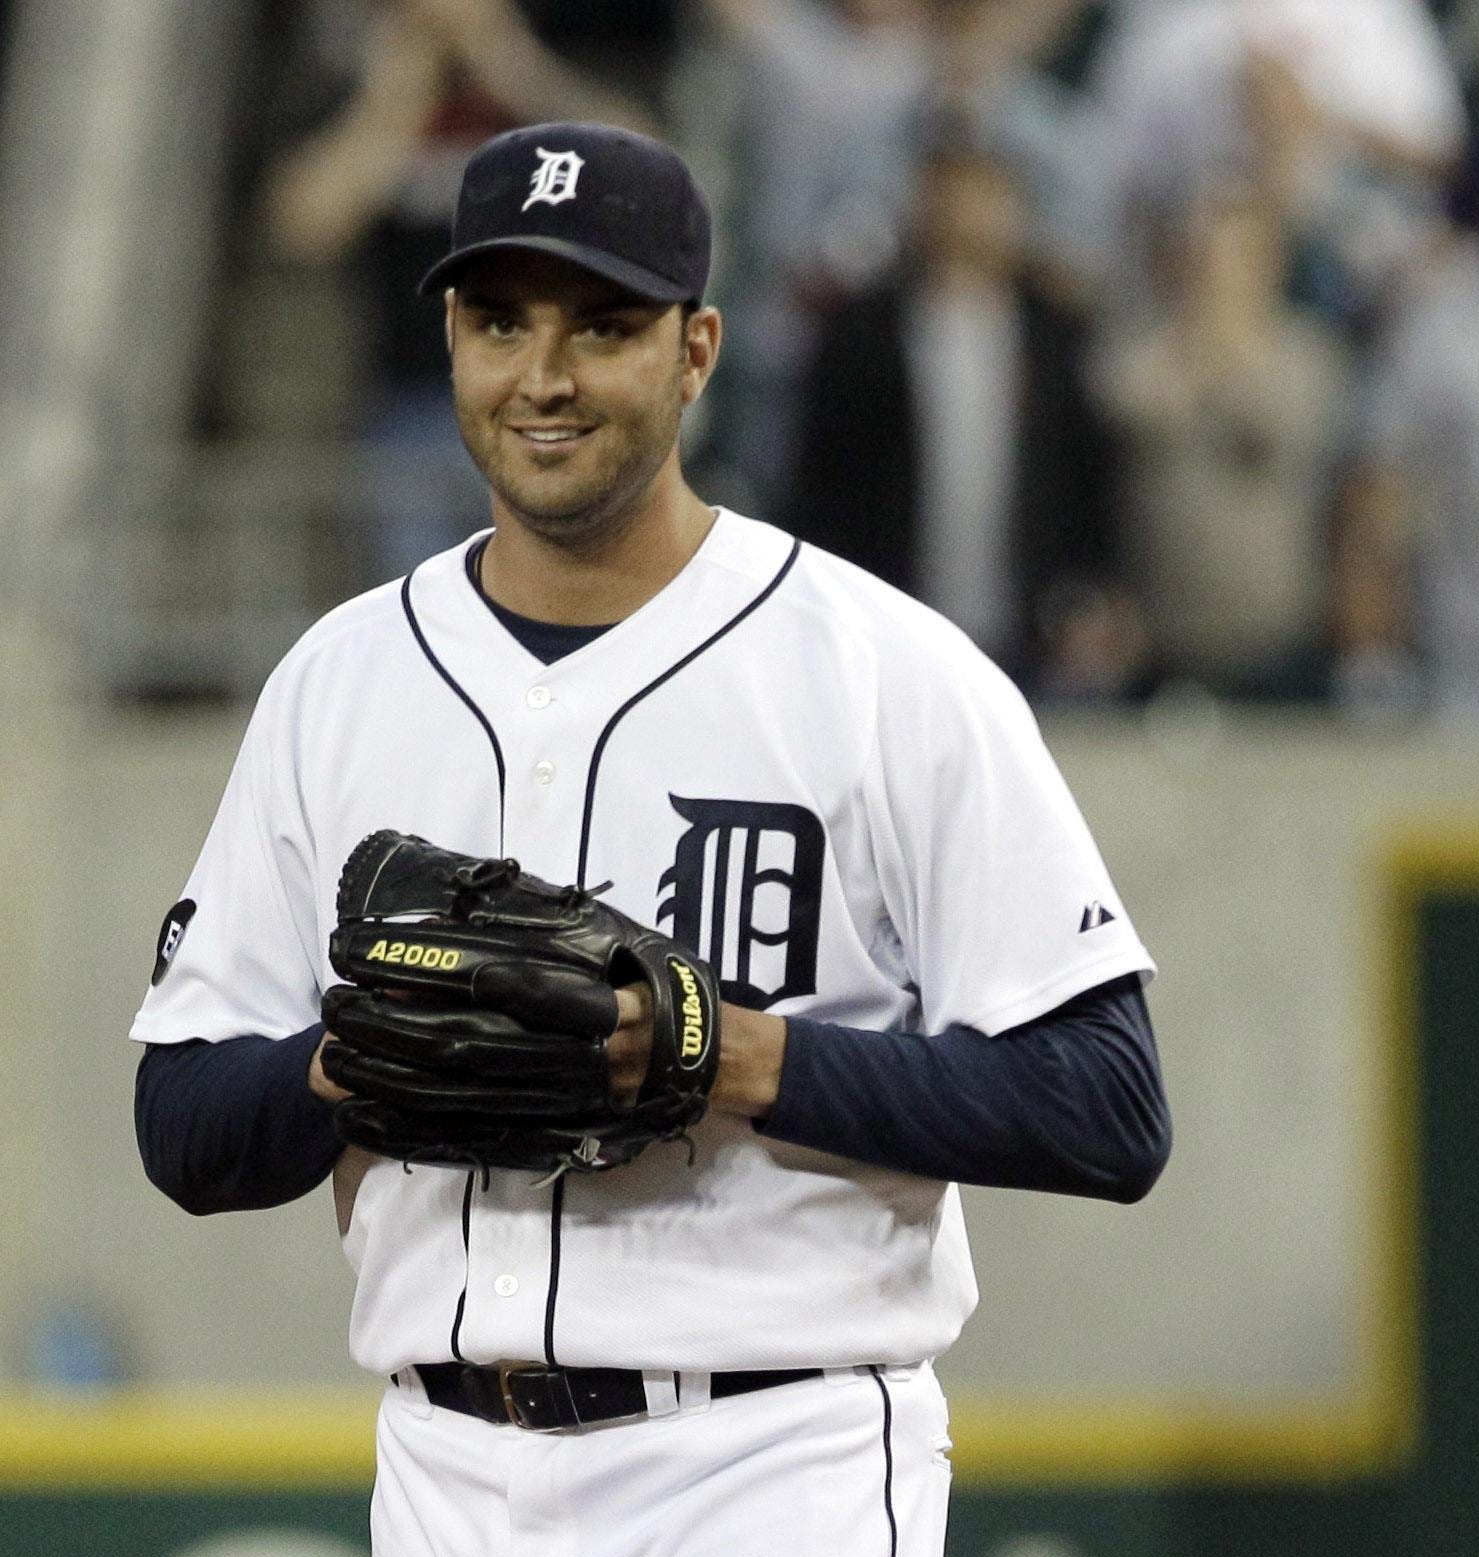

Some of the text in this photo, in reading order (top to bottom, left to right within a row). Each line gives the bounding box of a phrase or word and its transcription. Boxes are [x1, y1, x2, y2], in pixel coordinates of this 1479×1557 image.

[521, 146, 586, 212] D
[655, 791, 826, 1012] D
[366, 940, 462, 971] A2000
[670, 961, 704, 1057] Wilson
